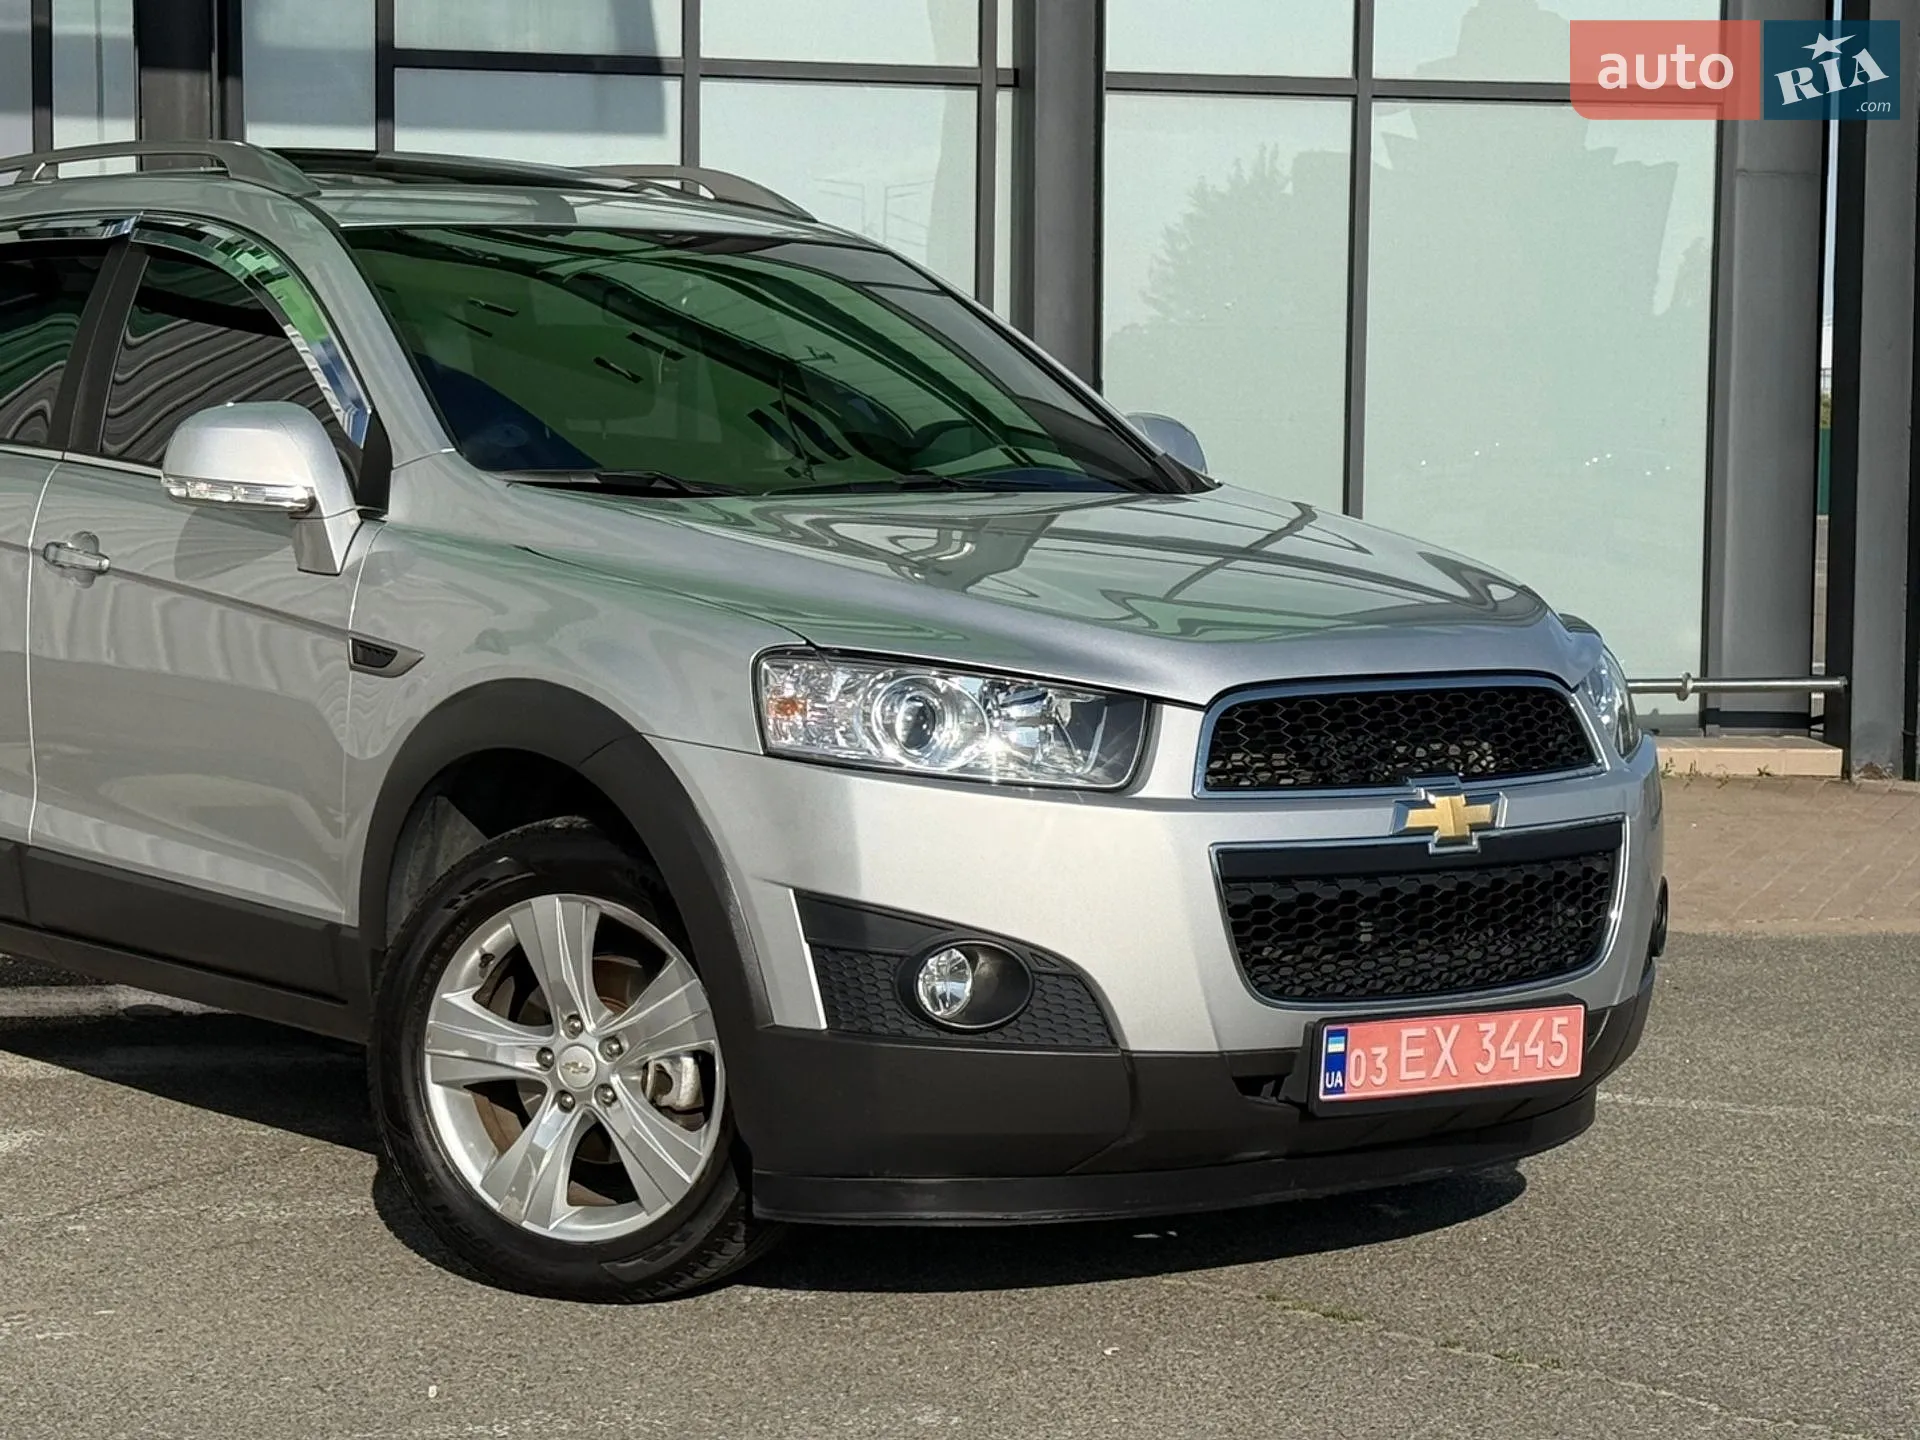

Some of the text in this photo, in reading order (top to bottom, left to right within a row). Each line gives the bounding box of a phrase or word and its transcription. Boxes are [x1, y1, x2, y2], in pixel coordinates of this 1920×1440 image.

[1350, 1016, 1569, 1087] 03 EX 3445
[1325, 1070, 1343, 1089] UA
